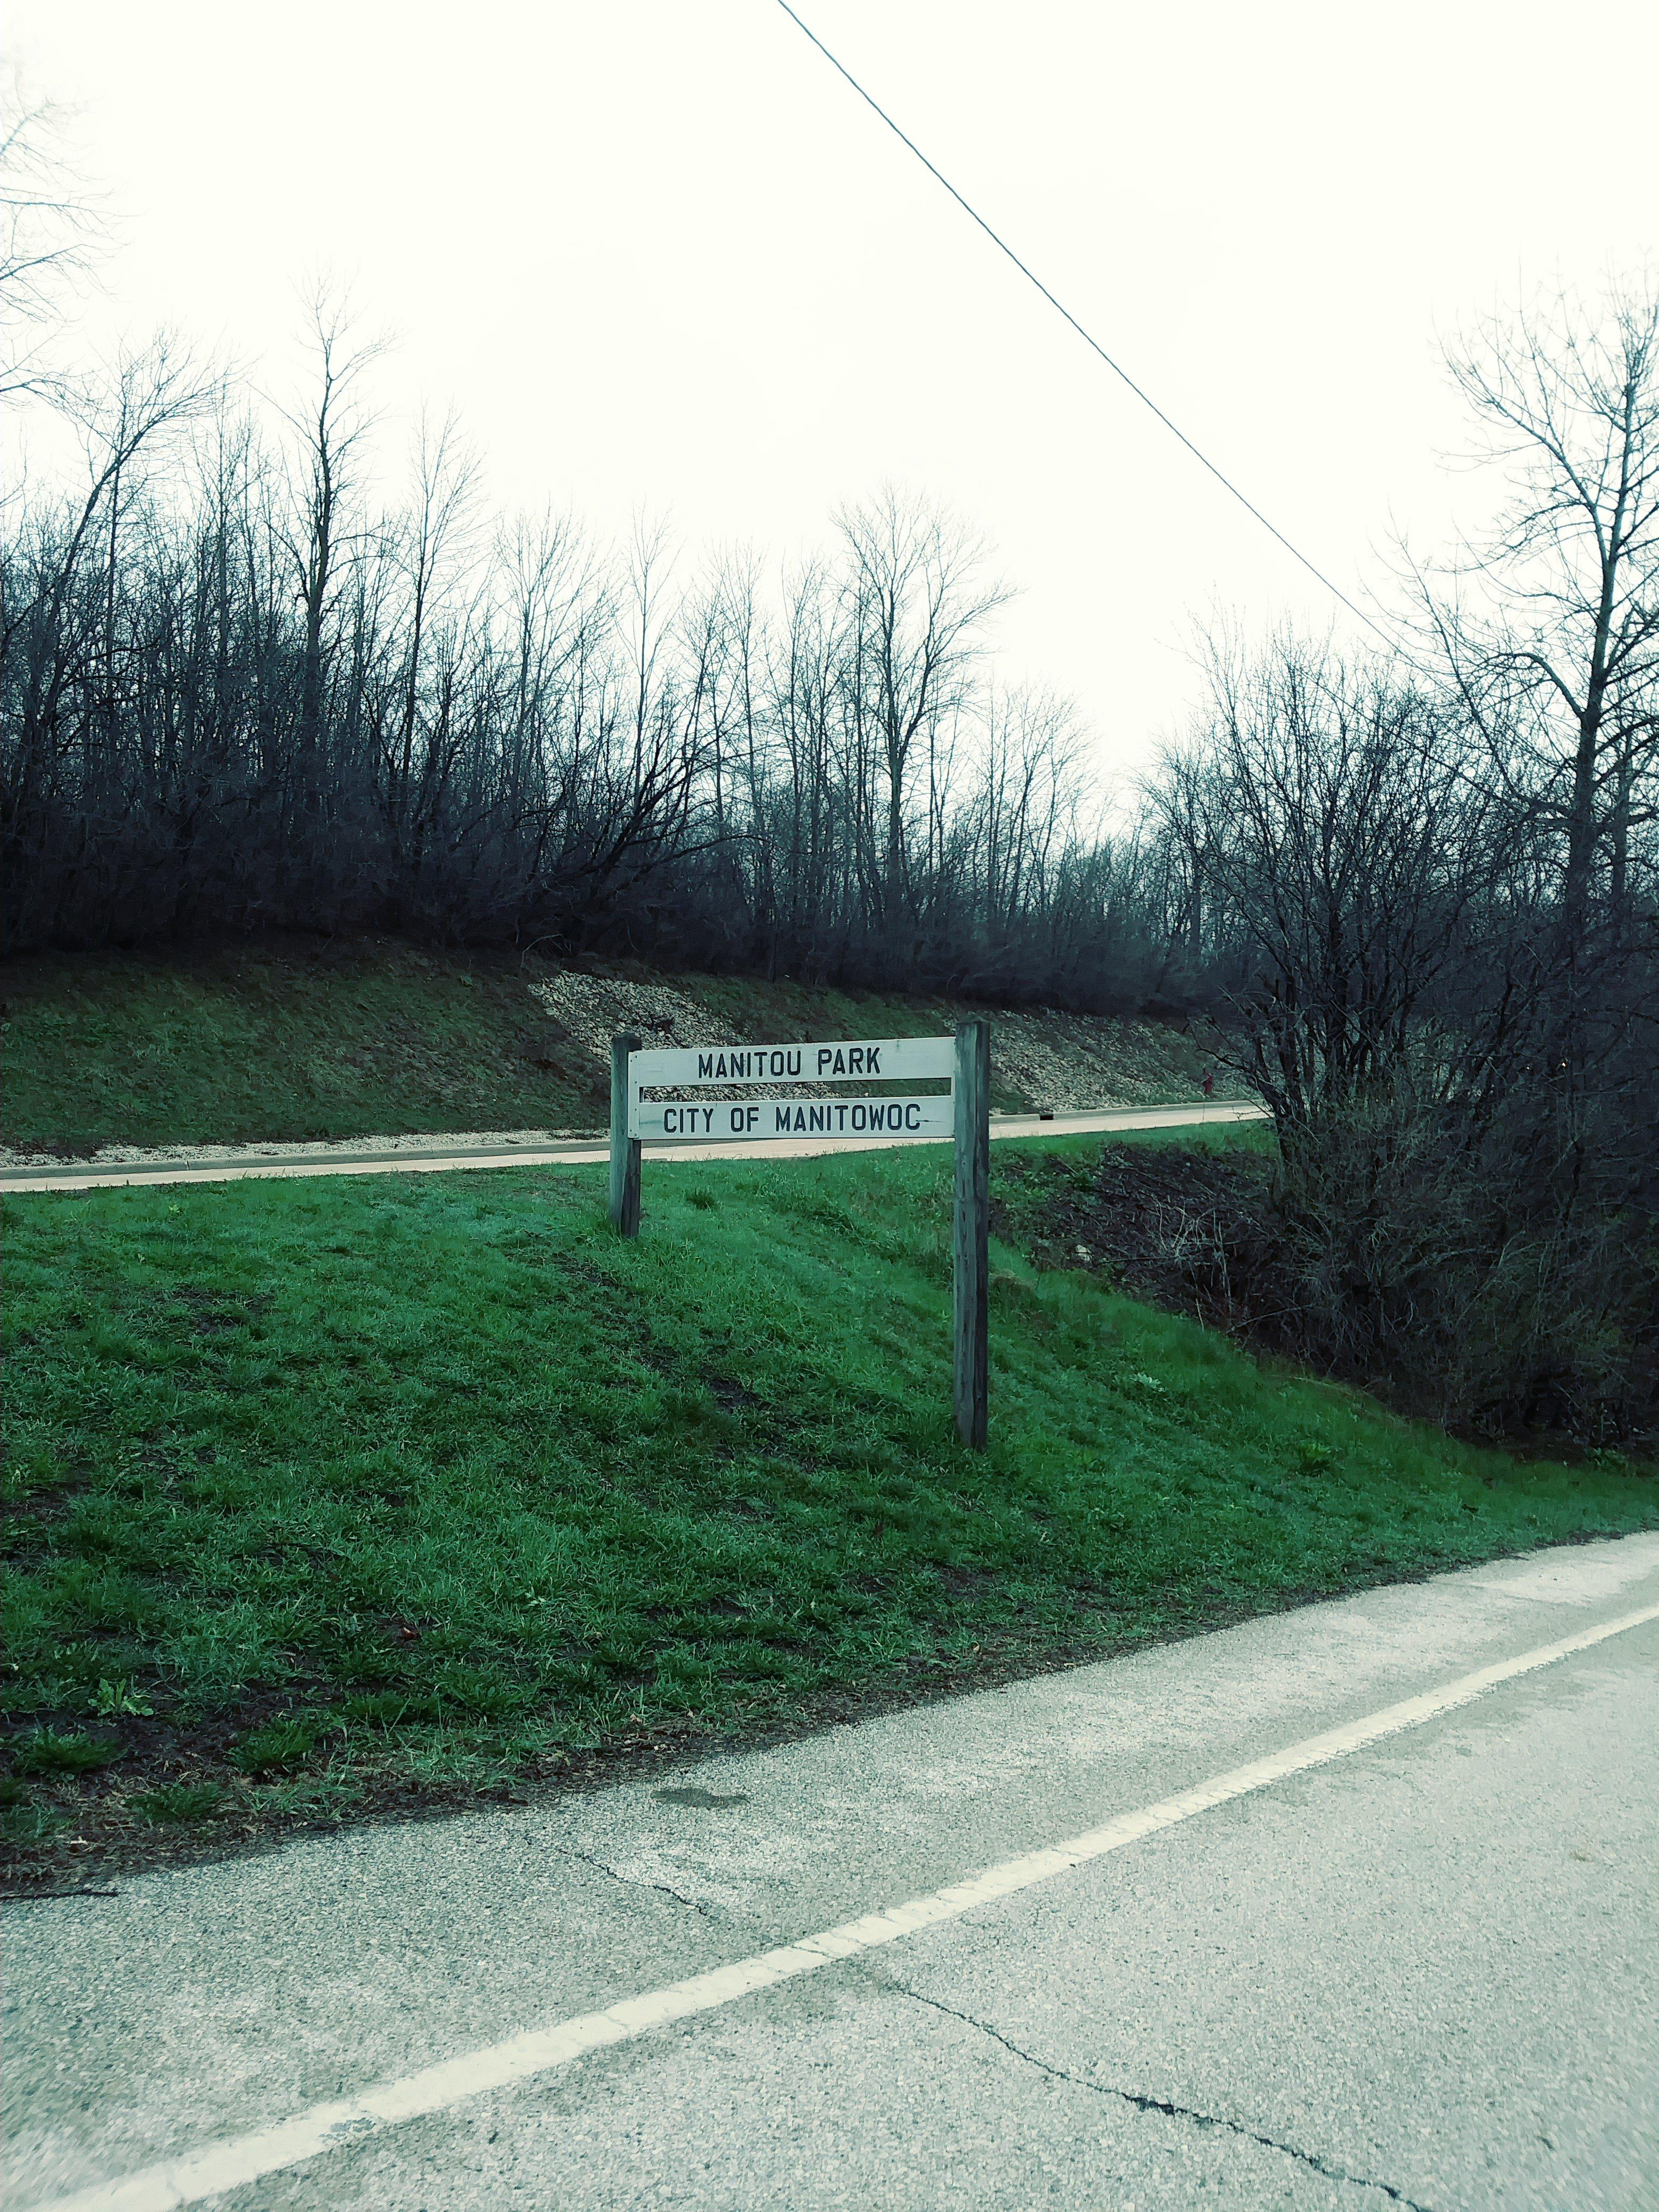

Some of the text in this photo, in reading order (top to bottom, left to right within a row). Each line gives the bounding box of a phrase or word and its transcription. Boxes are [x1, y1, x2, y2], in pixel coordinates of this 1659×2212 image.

[698, 1047, 881, 1078] MANITOU PARK
[664, 1103, 921, 1133] CITY OF MANITOWOC
